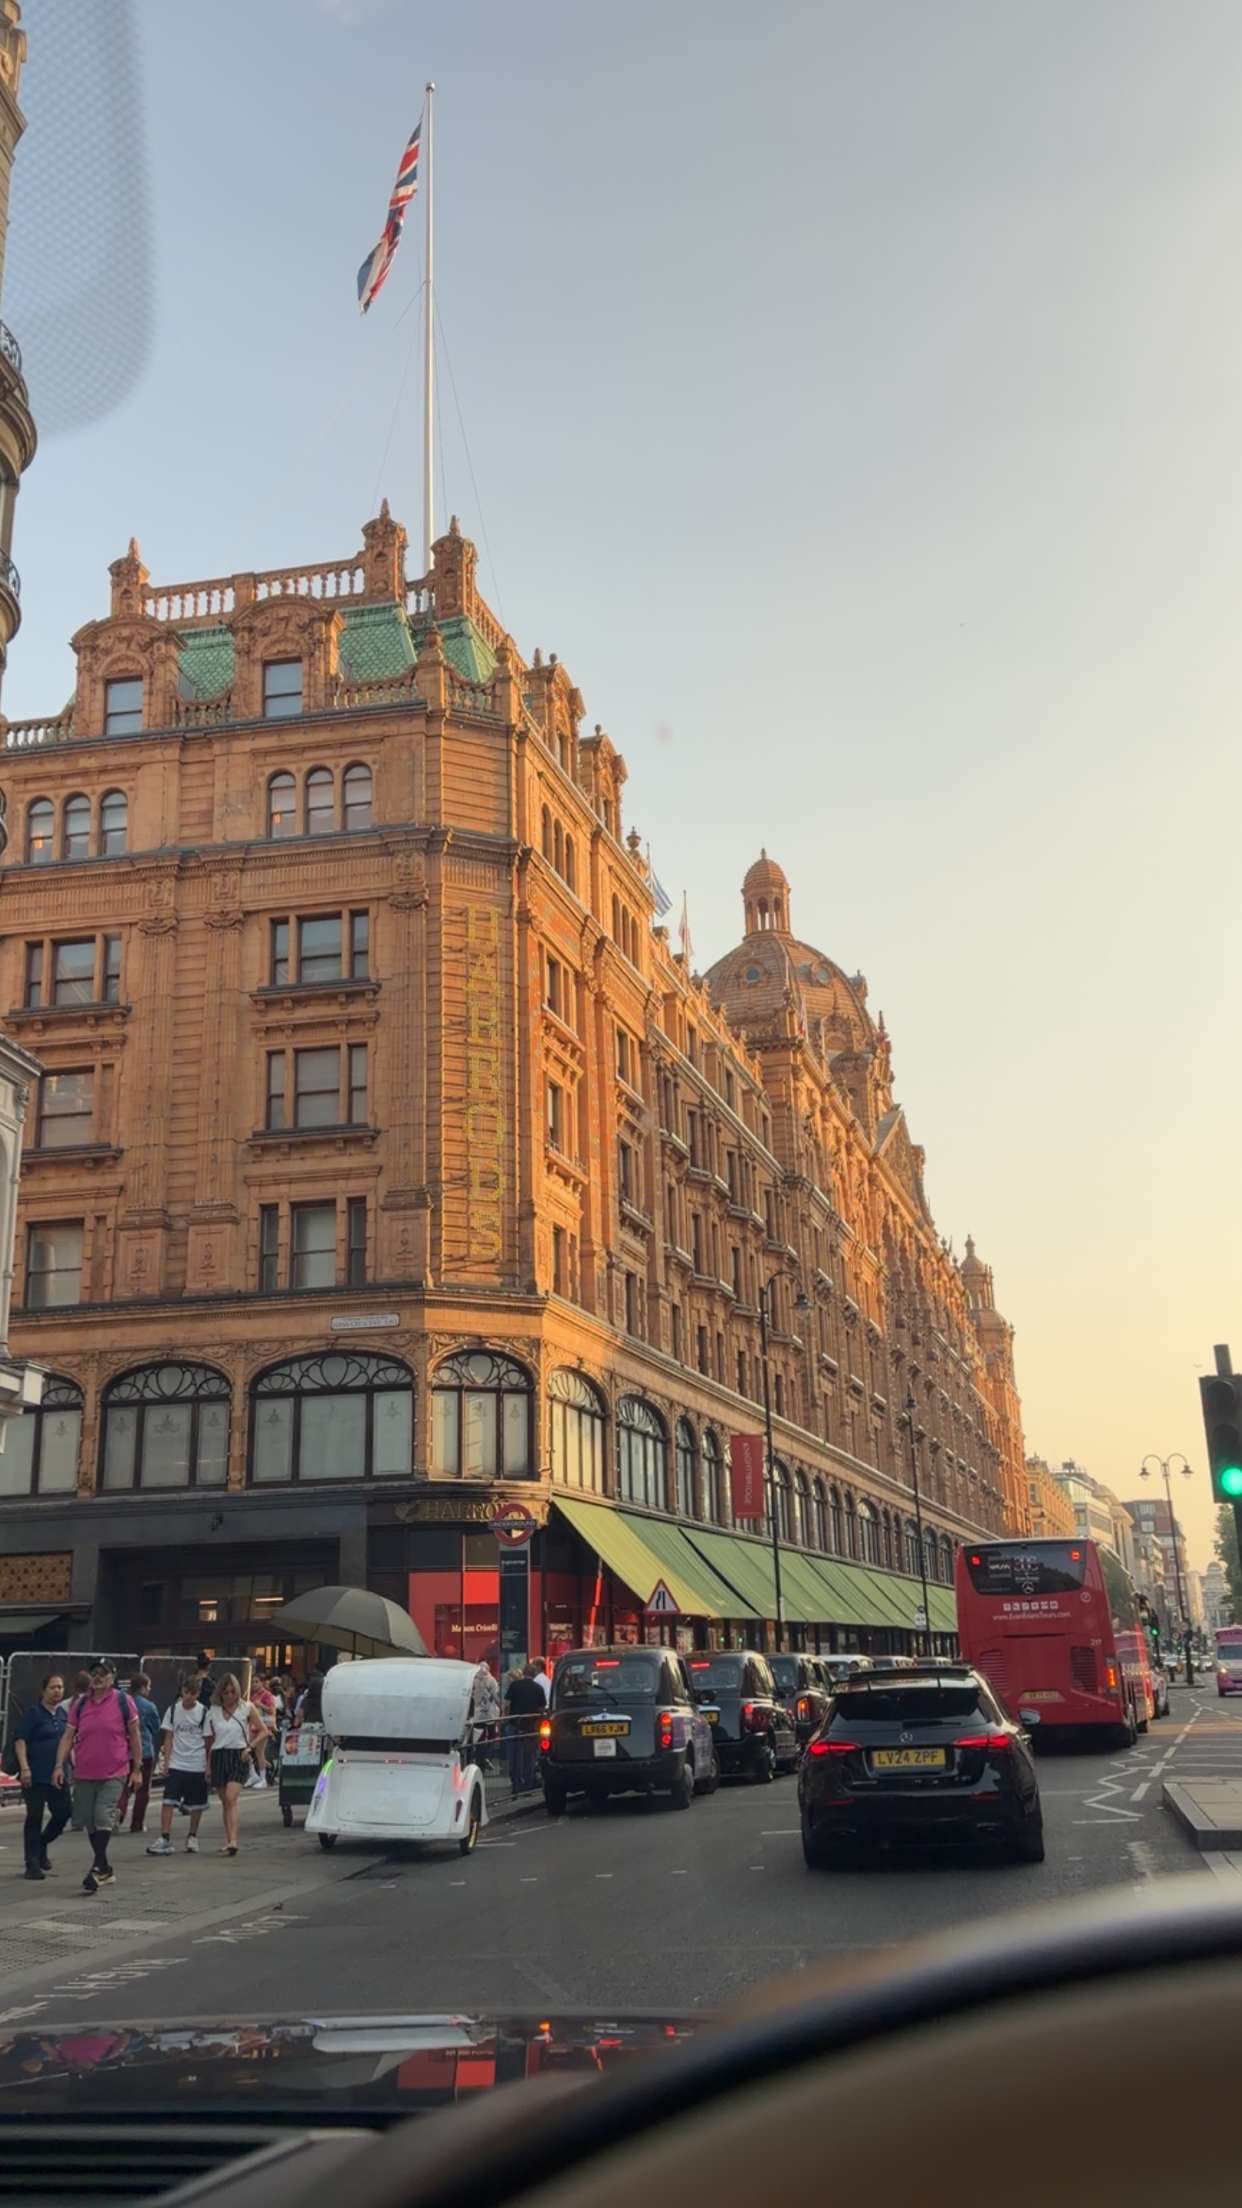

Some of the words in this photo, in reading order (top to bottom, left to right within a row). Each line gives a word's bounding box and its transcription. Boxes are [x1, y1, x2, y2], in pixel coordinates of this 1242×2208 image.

[466, 906, 504, 1255] HARRODS
[489, 1520, 536, 1528] UNDERGROUND
[878, 1752, 911, 1765] LV24
[914, 1751, 938, 1764] ZPF
